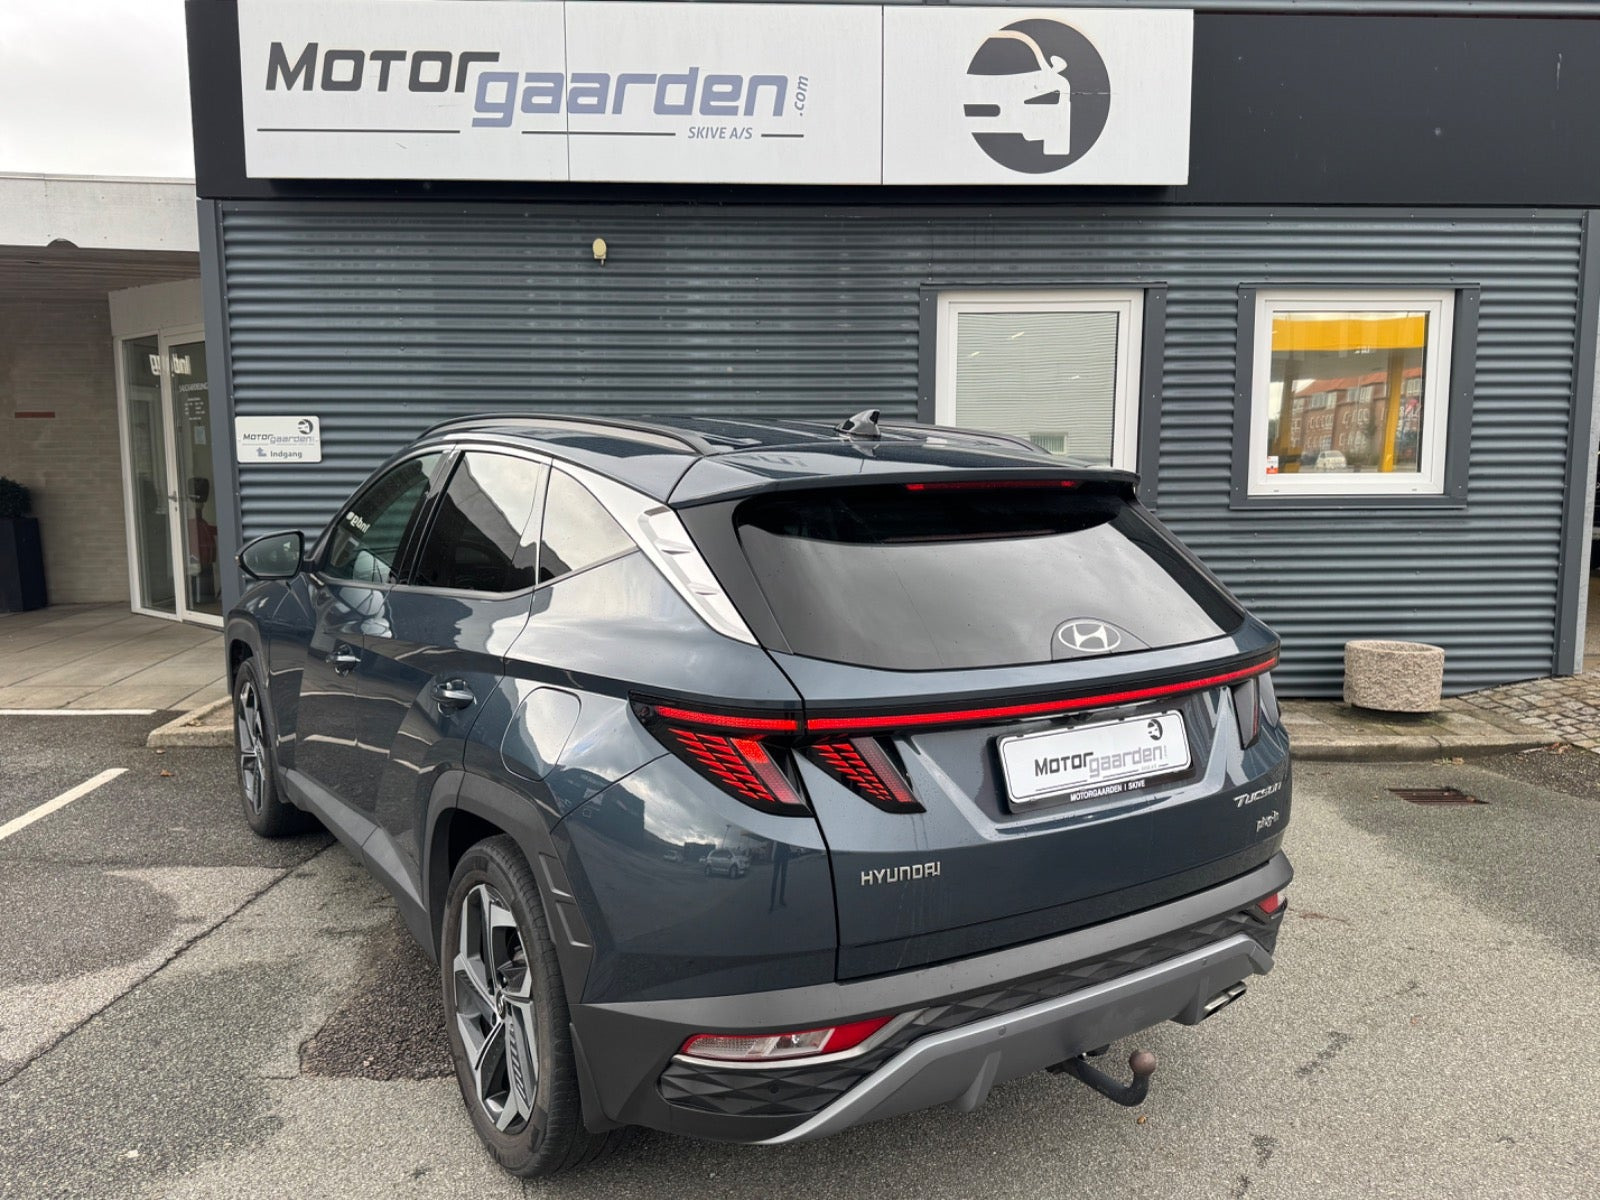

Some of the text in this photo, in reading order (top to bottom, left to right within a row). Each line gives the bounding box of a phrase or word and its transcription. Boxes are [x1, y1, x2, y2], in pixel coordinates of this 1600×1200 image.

[794, 75, 809, 117] .com
[688, 126, 753, 140] SKIVE A/S
[270, 450, 303, 458] Indgang
[1070, 783, 1122, 802] MOTORGAARDEN
[1128, 780, 1146, 791] SKIVE
[860, 861, 941, 886] HYUNDAI
